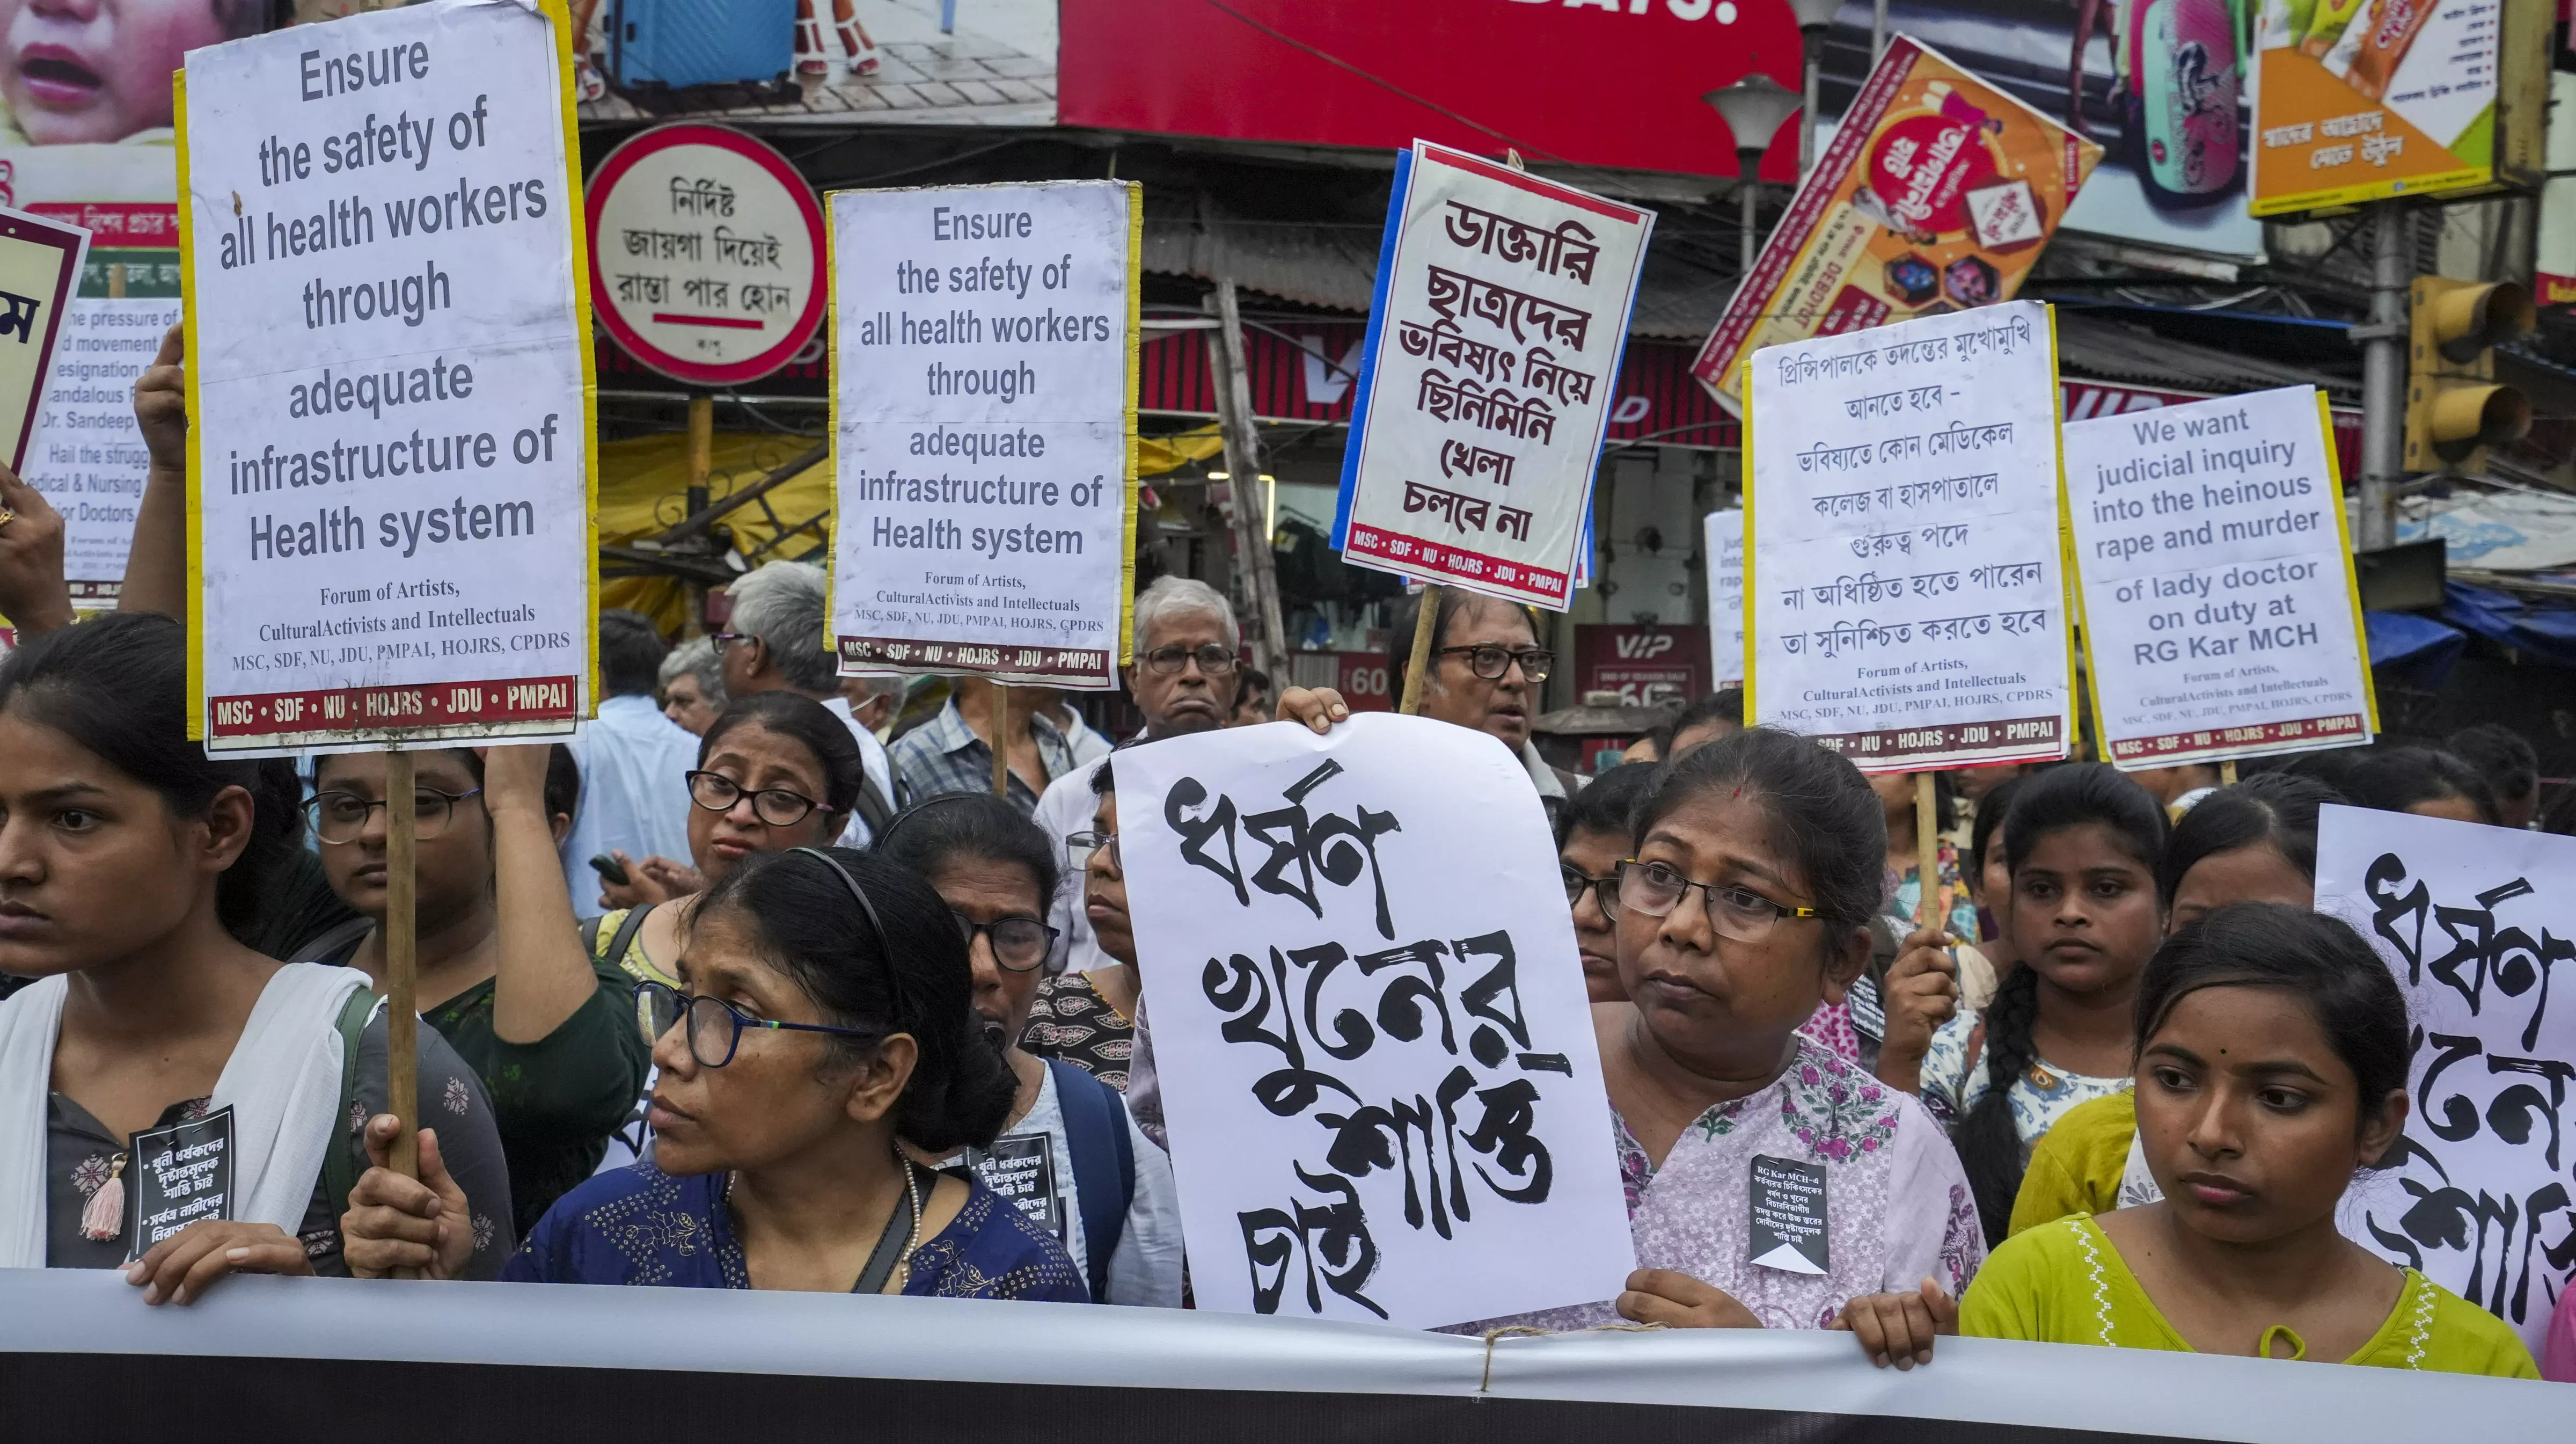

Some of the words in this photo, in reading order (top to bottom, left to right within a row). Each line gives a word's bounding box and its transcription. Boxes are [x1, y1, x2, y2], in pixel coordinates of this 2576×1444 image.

[299, 41, 430, 103] Ensure
[259, 135, 311, 187] the
[323, 110, 434, 172] safety
[448, 94, 487, 151] of
[670, 177, 737, 217] নির্দিষ্ট
[221, 217, 255, 270] all
[267, 196, 374, 260] health
[385, 179, 547, 234] workers
[934, 207, 1032, 240] Ensure
[1445, 199, 1600, 286] ডাক্তারি
[622, 229, 702, 262] জায়গা
[714, 225, 783, 271] দিয়েই
[303, 260, 450, 329] through
[616, 274, 669, 304] রাস্তা
[684, 277, 730, 308] পার
[741, 283, 792, 313] হোন
[897, 260, 939, 294] the
[949, 257, 1032, 300] safety
[1042, 253, 1071, 289] of
[91, 312, 158, 329] pressure
[163, 309, 178, 326] of
[861, 312, 890, 346] all
[902, 309, 981, 345] health
[992, 307, 1109, 342] workers
[1428, 264, 1592, 352] ছাত্রদের
[77, 337, 157, 352] movement
[1400, 319, 1516, 383] ভবিষ্যৎ
[1522, 346, 1596, 407] নিয়ে
[1779, 350, 1877, 387] প্রিন্সিপালকে
[1883, 336, 1948, 366] তদন্তের
[1953, 316, 2030, 362] মুখোমুখি
[290, 356, 473, 420] adequate
[927, 361, 1035, 404] through
[1844, 391, 1902, 420] আনতে
[1908, 385, 1942, 412] হবে
[67, 412, 134, 432] Sandeep
[1417, 368, 1556, 446] ছিনিমিনি
[2133, 419, 2175, 446] We
[2184, 408, 2249, 438] want
[49, 445, 75, 465] Hail
[80, 445, 102, 465] the
[231, 429, 496, 495] infrastructure
[513, 413, 558, 464] of
[910, 425, 1045, 464] adequate
[1440, 439, 1514, 486] খেলা
[1797, 441, 1872, 472] ভবিষ্যতে
[1879, 434, 1921, 463] কোন
[1929, 421, 2012, 455] মেডিকেল
[87, 473, 142, 499] Nursing
[2096, 450, 2193, 494] judicial
[2202, 441, 2296, 472] inquiry
[860, 470, 1059, 506] infrastructure
[1071, 475, 1103, 507] of
[1812, 491, 1870, 517] কলেজ
[1876, 483, 1892, 510] বা
[1899, 472, 1998, 509] হাসপাতালে
[2092, 498, 2143, 523] into
[2151, 490, 2193, 516] the
[2203, 476, 2312, 508] heinous
[251, 506, 365, 560] Health
[379, 496, 535, 558] system
[1403, 480, 1491, 535] চলবে
[1496, 505, 1533, 542] না
[873, 516, 962, 550] Health
[971, 523, 1083, 559] system
[1850, 530, 1912, 559] গুরুত্ব
[1921, 523, 1968, 549] পদে
[2096, 533, 2154, 562] rape
[2164, 520, 2213, 549] and
[2222, 509, 2321, 542] murder
[1354, 530, 1378, 549] MSC
[1389, 539, 1411, 557] SDF
[1422, 547, 1438, 563] NU
[1448, 554, 1483, 575] HOJRS
[1494, 564, 1516, 582] JDU
[1528, 572, 1562, 593] PMPAI
[2116, 579, 2143, 603] of
[2153, 572, 2212, 599] lady
[2223, 560, 2318, 589] doctor
[320, 588, 371, 606] Forum
[377, 585, 391, 600] of
[397, 579, 460, 599] Artists,
[1781, 585, 1804, 611] না
[1811, 571, 1903, 607] অধিষ্ঠিত
[1911, 571, 1959, 599] হতে
[1970, 561, 2042, 590] পারেন
[260, 617, 386, 643] CulturalActivists
[392, 611, 421, 631] and
[428, 605, 535, 629] Intellectuals
[2149, 611, 2184, 631] on
[2194, 601, 2257, 626] duty
[2268, 594, 2296, 616] at
[1615, 634, 1674, 659] VIP
[1780, 631, 1807, 656] তা
[1814, 619, 1912, 659] সুনিশ্চিত
[1919, 614, 1991, 643] করতে
[1998, 609, 2046, 639] হবে
[2134, 639, 2178, 666] RG
[2189, 633, 2239, 659] Kar
[2248, 622, 2318, 652] MCH
[1351, 667, 1388, 696] 60
[217, 701, 253, 725] MSC
[275, 697, 304, 722] SDF
[324, 695, 346, 719] NU
[367, 690, 423, 717] HOJRS
[447, 688, 482, 713] JDU
[508, 683, 567, 710] PMPAI
[1163, 757, 1402, 940] ধর্ষণ
[2365, 852, 2576, 1053] ধর্ষণ
[152, 1150, 173, 1175] খুনী
[175, 1137, 224, 1162] ধর্ষকদের
[158, 1157, 219, 1188] দৃষ্টান্তমূলক
[979, 1158, 996, 1175] খুনী
[999, 1155, 1041, 1170] ধর্ষকদের
[1315, 1065, 1553, 1241] শাস্তি
[1758, 1165, 1769, 1175] RG
[1771, 1170, 1786, 1179] Kar
[164, 1181, 191, 1199] শাস্তি
[194, 1175, 214, 1192] চাই
[985, 1169, 1037, 1187] দৃষ্টান্তমূলক
[1018, 1182, 1035, 1193] চাই
[1754, 1175, 1782, 1188] কর্তব্যরত
[1783, 1181, 1822, 1195] চিকিৎসকের
[1767, 1189, 1780, 1199] ধর্ষণ
[1790, 1194, 1809, 1204] খুনের
[150, 1208, 177, 1227] সর্বত্র
[180, 1193, 224, 1217] নারীদের
[1754, 1206, 1770, 1217] তদন্ত
[1772, 1210, 1787, 1220] করে
[1788, 1213, 1801, 1222] উচ্চ
[1803, 1216, 1822, 1226] স্তরের
[1756, 1216, 1784, 1230] দোষীদের
[1785, 1223, 1821, 1236] দৃষ্টান্তমূলক
[1766, 1198, 1810, 1214] বিচারবিভাগীয়
[1237, 1159, 1389, 1321] চাই
[1774, 1231, 1789, 1241] শাস্তি
[1791, 1234, 1803, 1244] চাই
